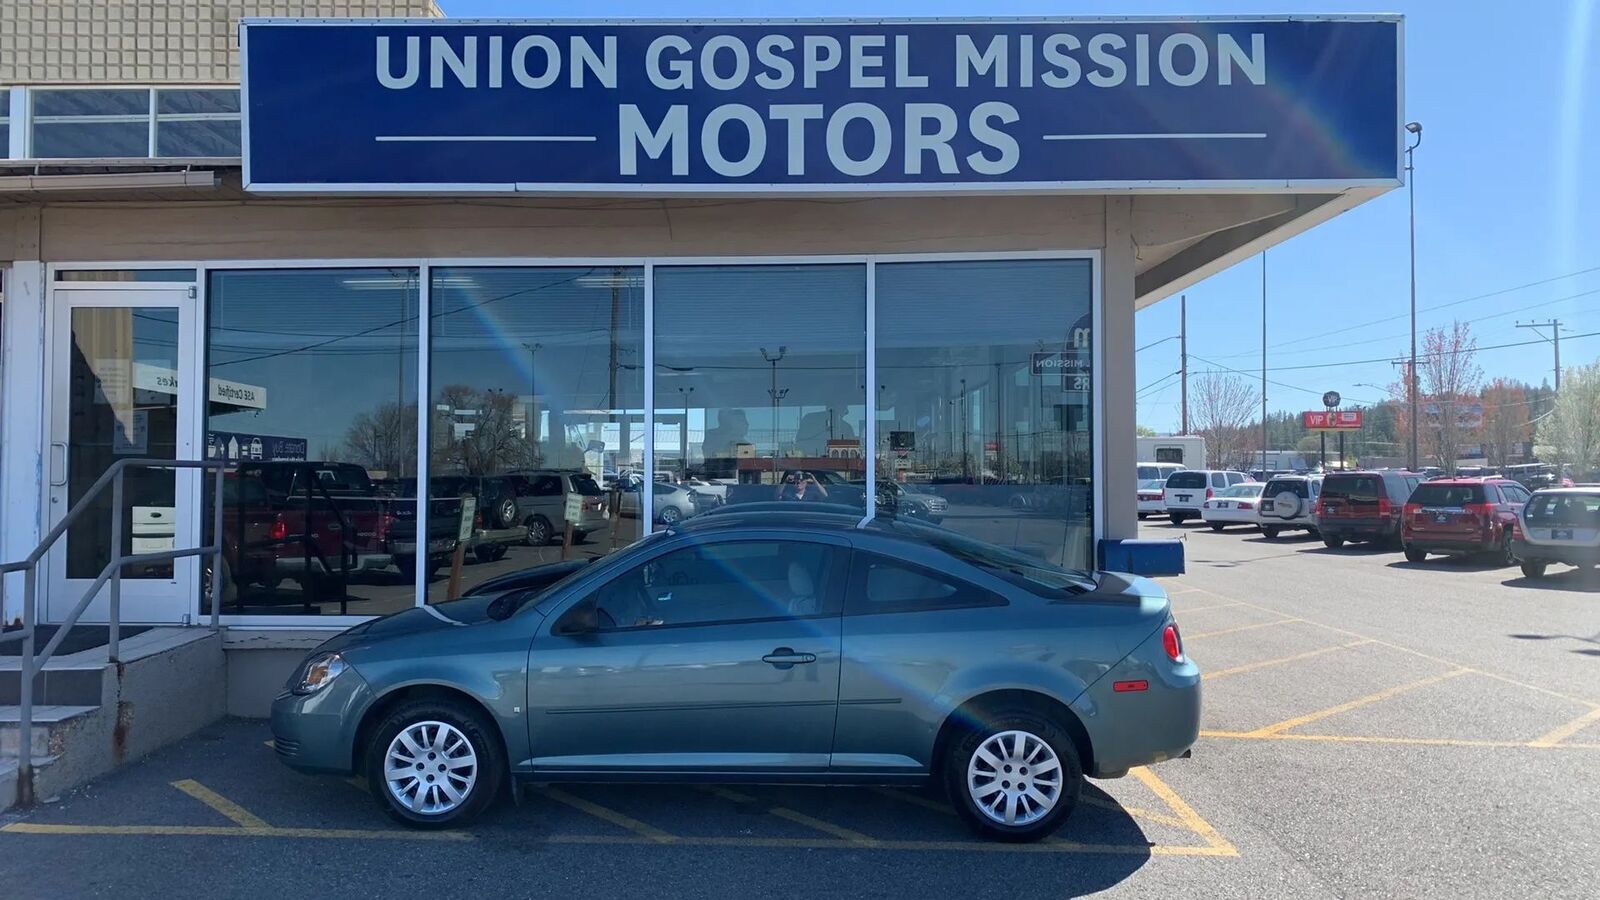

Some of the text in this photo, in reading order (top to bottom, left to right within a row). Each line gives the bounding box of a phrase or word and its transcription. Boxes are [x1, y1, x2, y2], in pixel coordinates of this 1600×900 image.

[375, 32, 1267, 91] UNION GOSPEL MISSION
[617, 101, 1021, 178] MOTORS
[1309, 415, 1324, 425] VIP
